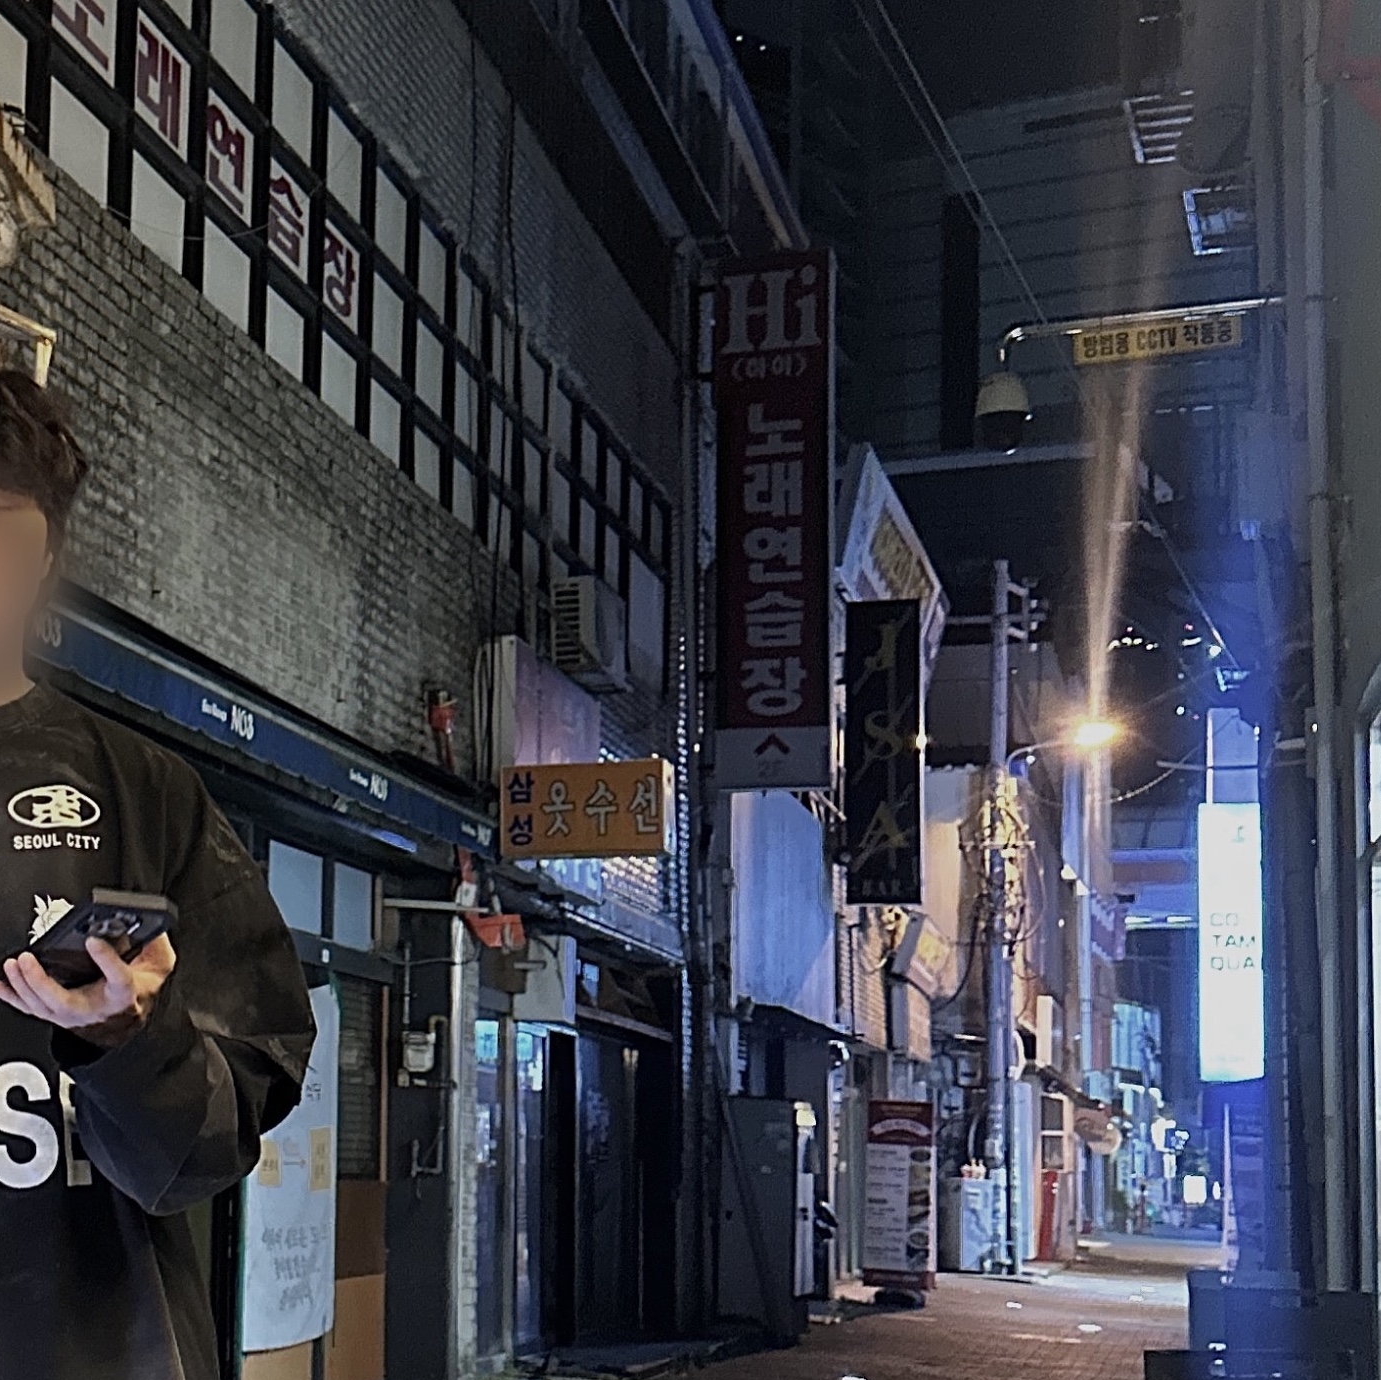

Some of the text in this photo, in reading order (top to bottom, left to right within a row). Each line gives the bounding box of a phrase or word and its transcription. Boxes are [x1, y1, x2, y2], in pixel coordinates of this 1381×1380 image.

[721, 264, 822, 354] Hi
[1083, 332, 1129, 359] 방범용
[1136, 327, 1178, 350] CCTV
[741, 402, 807, 717] 노래연습장
[13, 832, 100, 850] SEOUL CITY
[507, 771, 534, 846] 삼성
